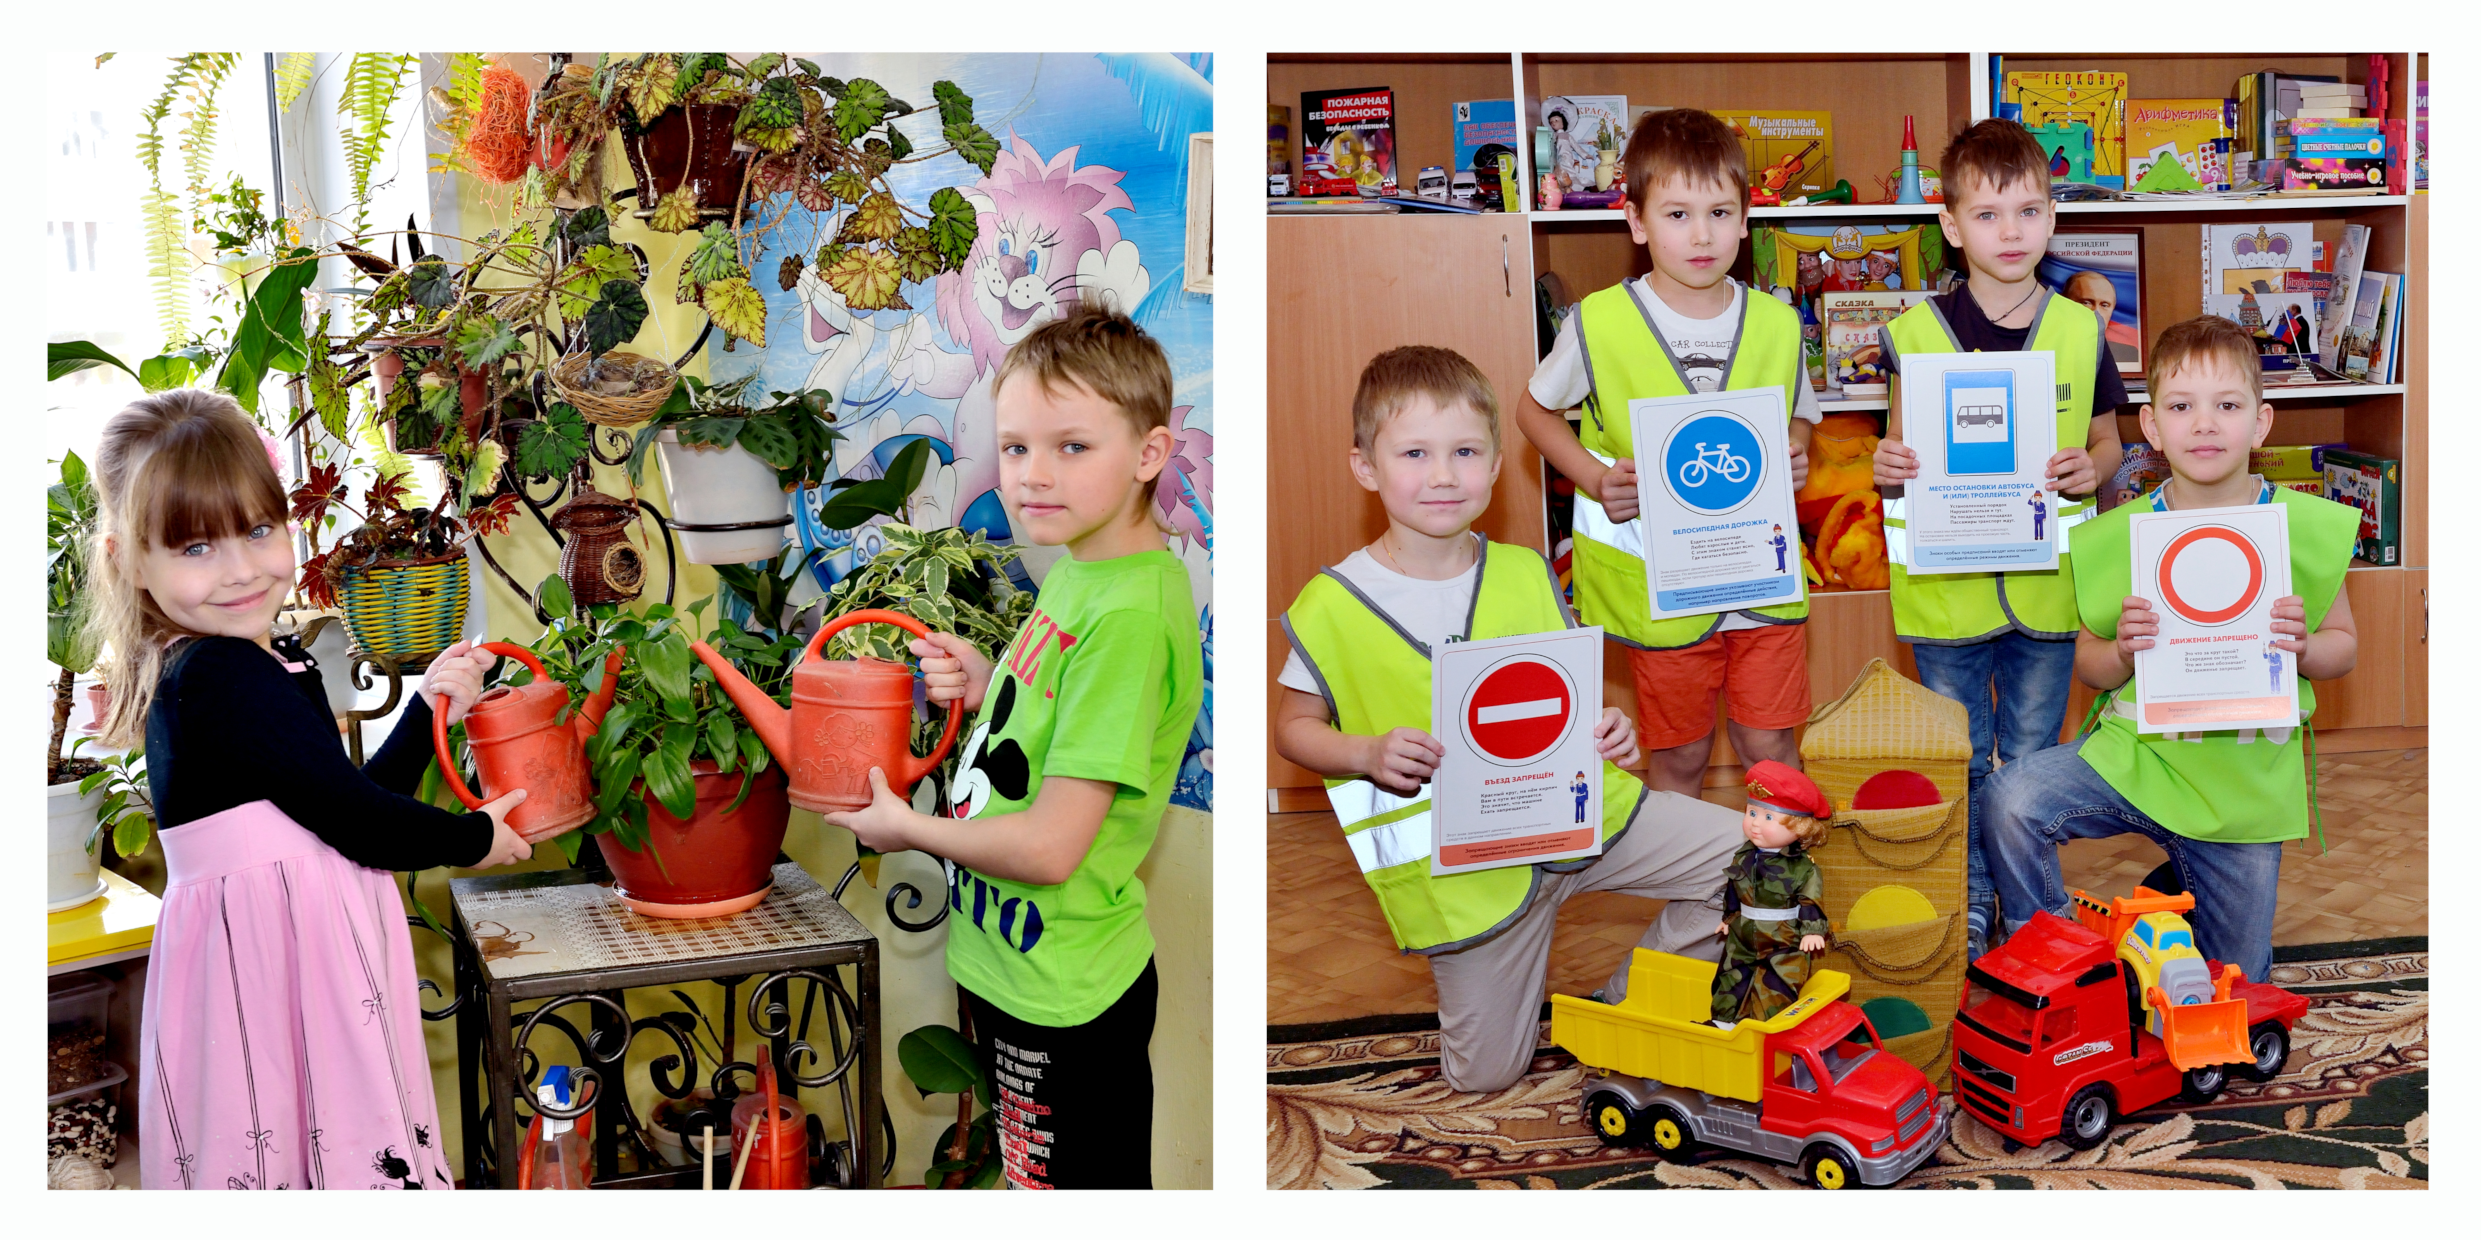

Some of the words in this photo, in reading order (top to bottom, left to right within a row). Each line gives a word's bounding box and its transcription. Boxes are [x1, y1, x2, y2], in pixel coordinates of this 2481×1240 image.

[2046, 74, 2114, 85] ГЕОКОНТ
[1328, 96, 1388, 108] ПОЖАРНАЯ
[1309, 108, 1389, 120] БЕЗОПАСНОСТЬ
[2134, 107, 2218, 123] Арифметика
[1749, 115, 1816, 130] Музыкальные
[1761, 127, 1824, 139] инструменты
[2302, 143, 2322, 151] ЦВЕТНЫЕ
[2323, 143, 2344, 151] СЧЕТНЫЕ
[2345, 143, 2366, 151] ПАЛОЧКИ
[2291, 171, 2339, 182] Учебно-игровое
[1802, 183, 1820, 191] Скрипка
[2288, 278, 2313, 288] Люблю
[2315, 280, 2331, 288] тебя
[1671, 340, 1690, 349] CAR
[2120, 450, 2166, 469] НИМАТЕ
[2114, 465, 2139, 482] УРОКИ
[1673, 524, 1729, 535] ВЕЛОСИПЕДНАЯ
[1731, 519, 1768, 529] ДОРОЖКА
[2170, 637, 2211, 645] ДВИЖЕНИЕ
[2213, 634, 2258, 642] ЗАПРЕЩЕНО
[1512, 771, 1553, 782] ЗАПРЕЩЁН
[1019, 1049, 1051, 1063] MARVEL
[1025, 1081, 1035, 1093] OF
